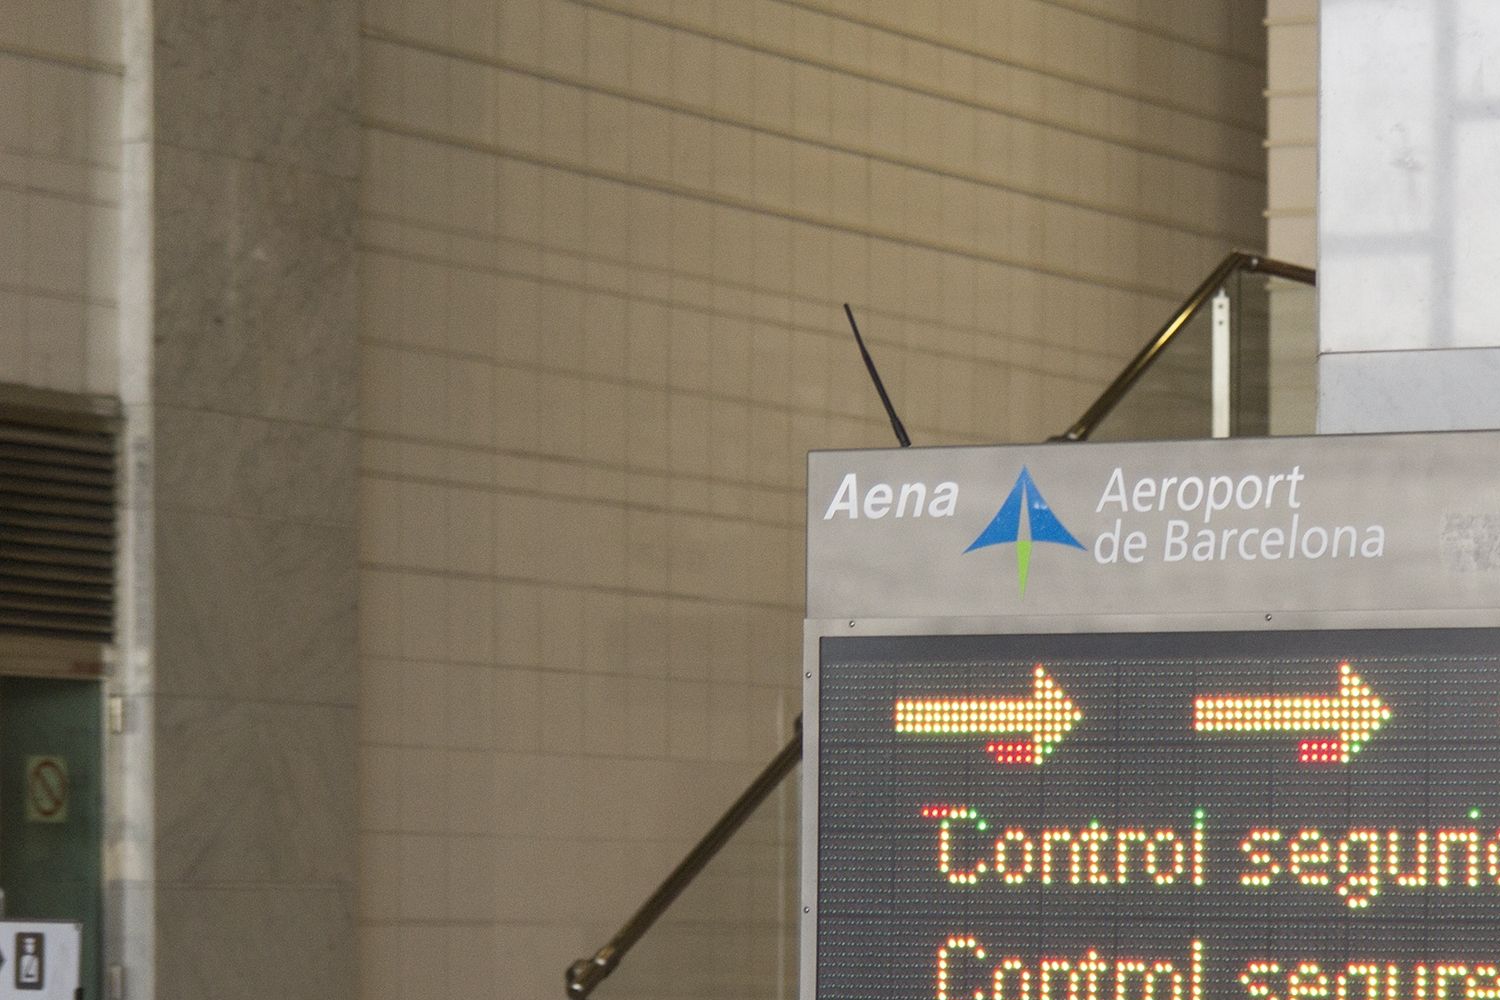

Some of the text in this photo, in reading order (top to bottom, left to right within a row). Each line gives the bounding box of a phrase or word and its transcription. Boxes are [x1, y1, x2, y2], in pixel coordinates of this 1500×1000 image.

[823, 472, 960, 521] Aena
[1095, 464, 1306, 522] Aeroport
[1093, 513, 1387, 565] de Barcelona
[936, 809, 1204, 886] Control
